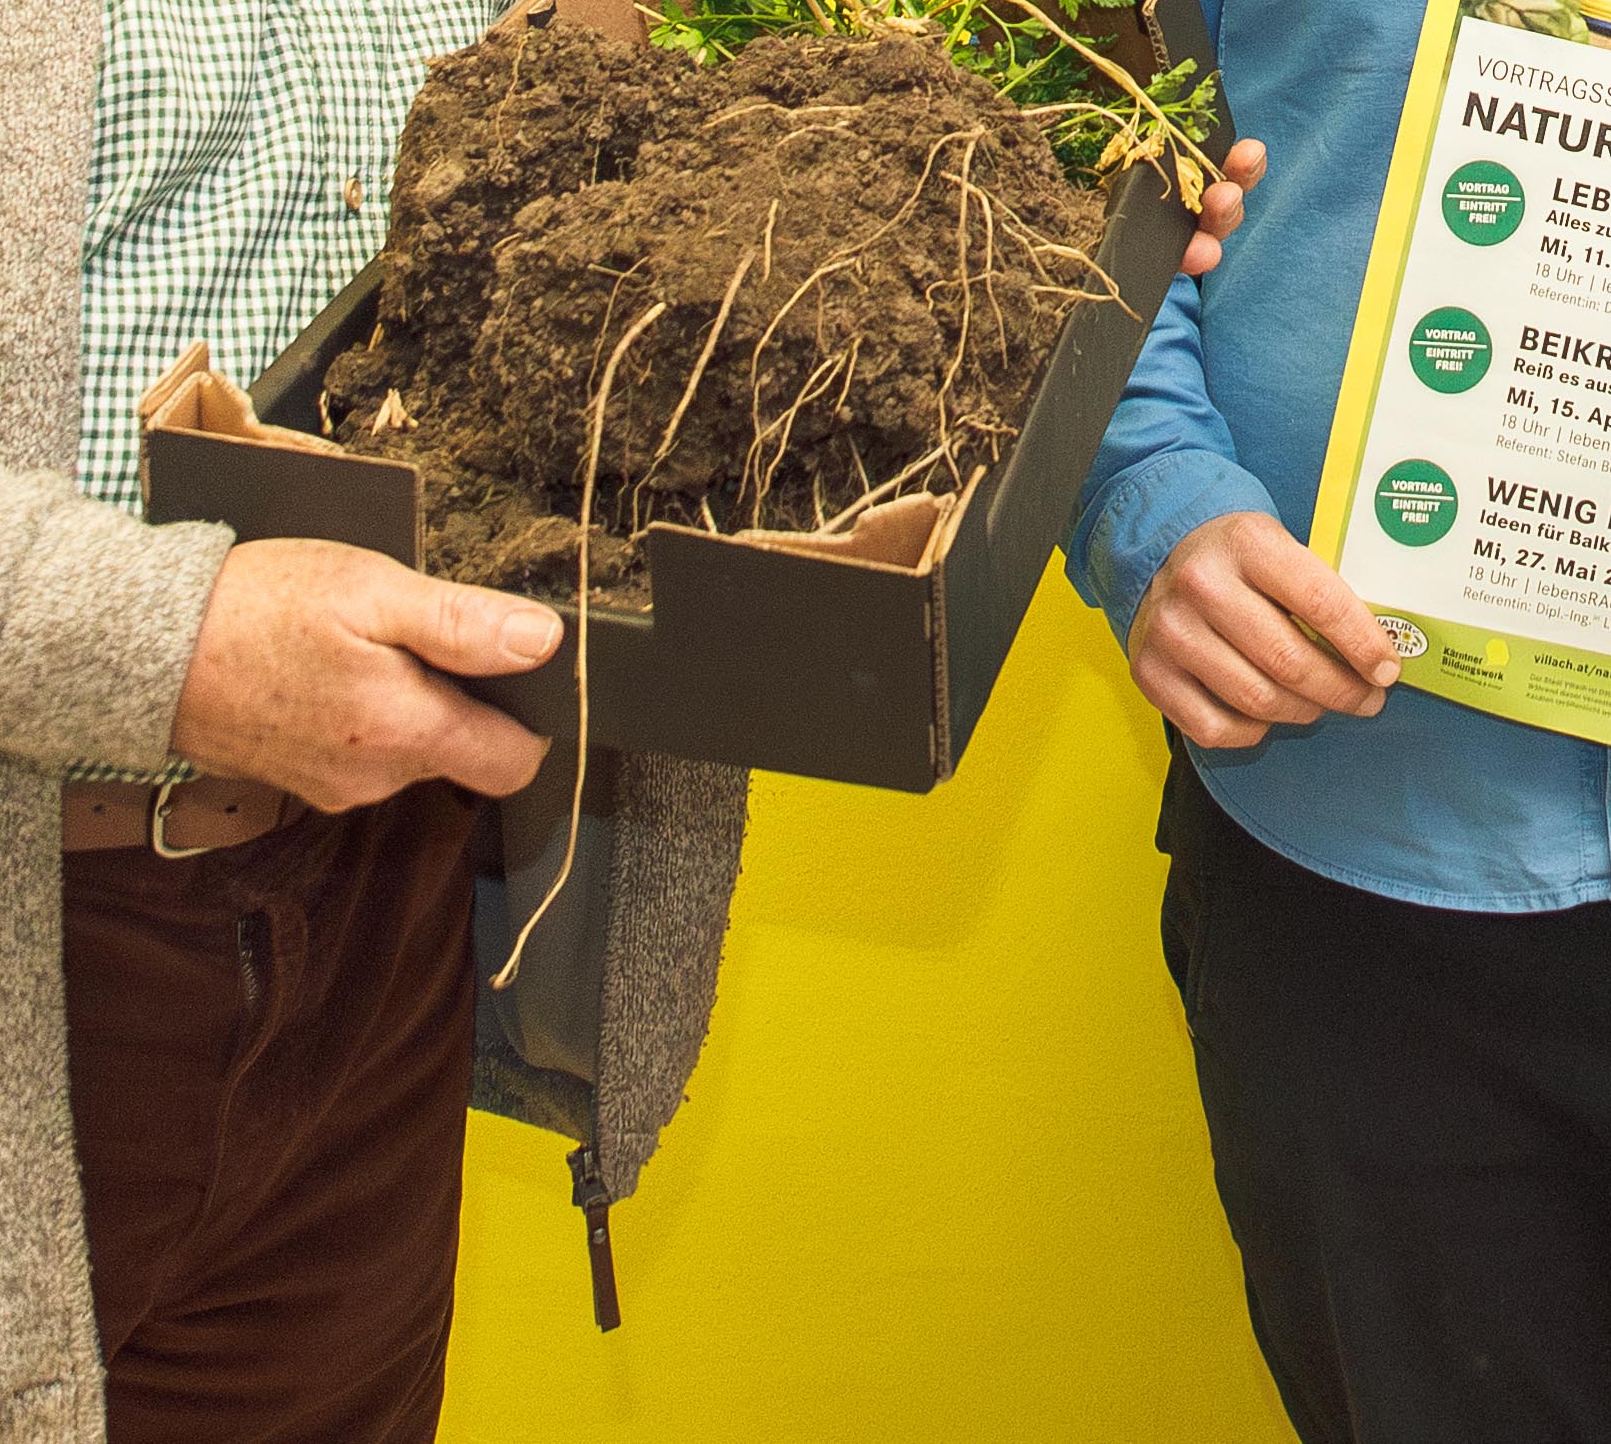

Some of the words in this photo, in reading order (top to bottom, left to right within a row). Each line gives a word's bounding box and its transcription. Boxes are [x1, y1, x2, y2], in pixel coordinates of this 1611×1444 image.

[1458, 181, 1510, 195] VORTRAG
[1459, 200, 1508, 213] EINTRITT
[1545, 209, 1592, 233] Alles
[1540, 234, 1573, 264] Mi,
[1584, 246, 1611, 269] 11.
[1535, 262, 1551, 279] 18
[1556, 266, 1584, 286] Uhr
[1425, 329, 1476, 342] VORTRAG
[1425, 347, 1474, 360] EINTRITT
[1513, 356, 1554, 380] Reiß
[1558, 372, 1580, 387] es
[1506, 386, 1539, 415] Mi,
[1551, 397, 1580, 421] 15.
[1502, 413, 1518, 435] 18
[1520, 417, 1551, 443] Uhr
[1495, 434, 1553, 460] Referent:
[1556, 447, 1599, 471] Stefan
[1391, 479, 1443, 494] VORTRAG
[1487, 476, 1597, 525] WENIG
[1392, 498, 1440, 512] EINTRITT
[1479, 508, 1532, 535] Ideen
[1537, 522, 1565, 542] für
[1473, 538, 1507, 567] Mi,
[1514, 548, 1546, 571] 27.
[1554, 556, 1598, 582] Mai
[1468, 562, 1487, 586] 18
[1487, 565, 1520, 593] Uhr
